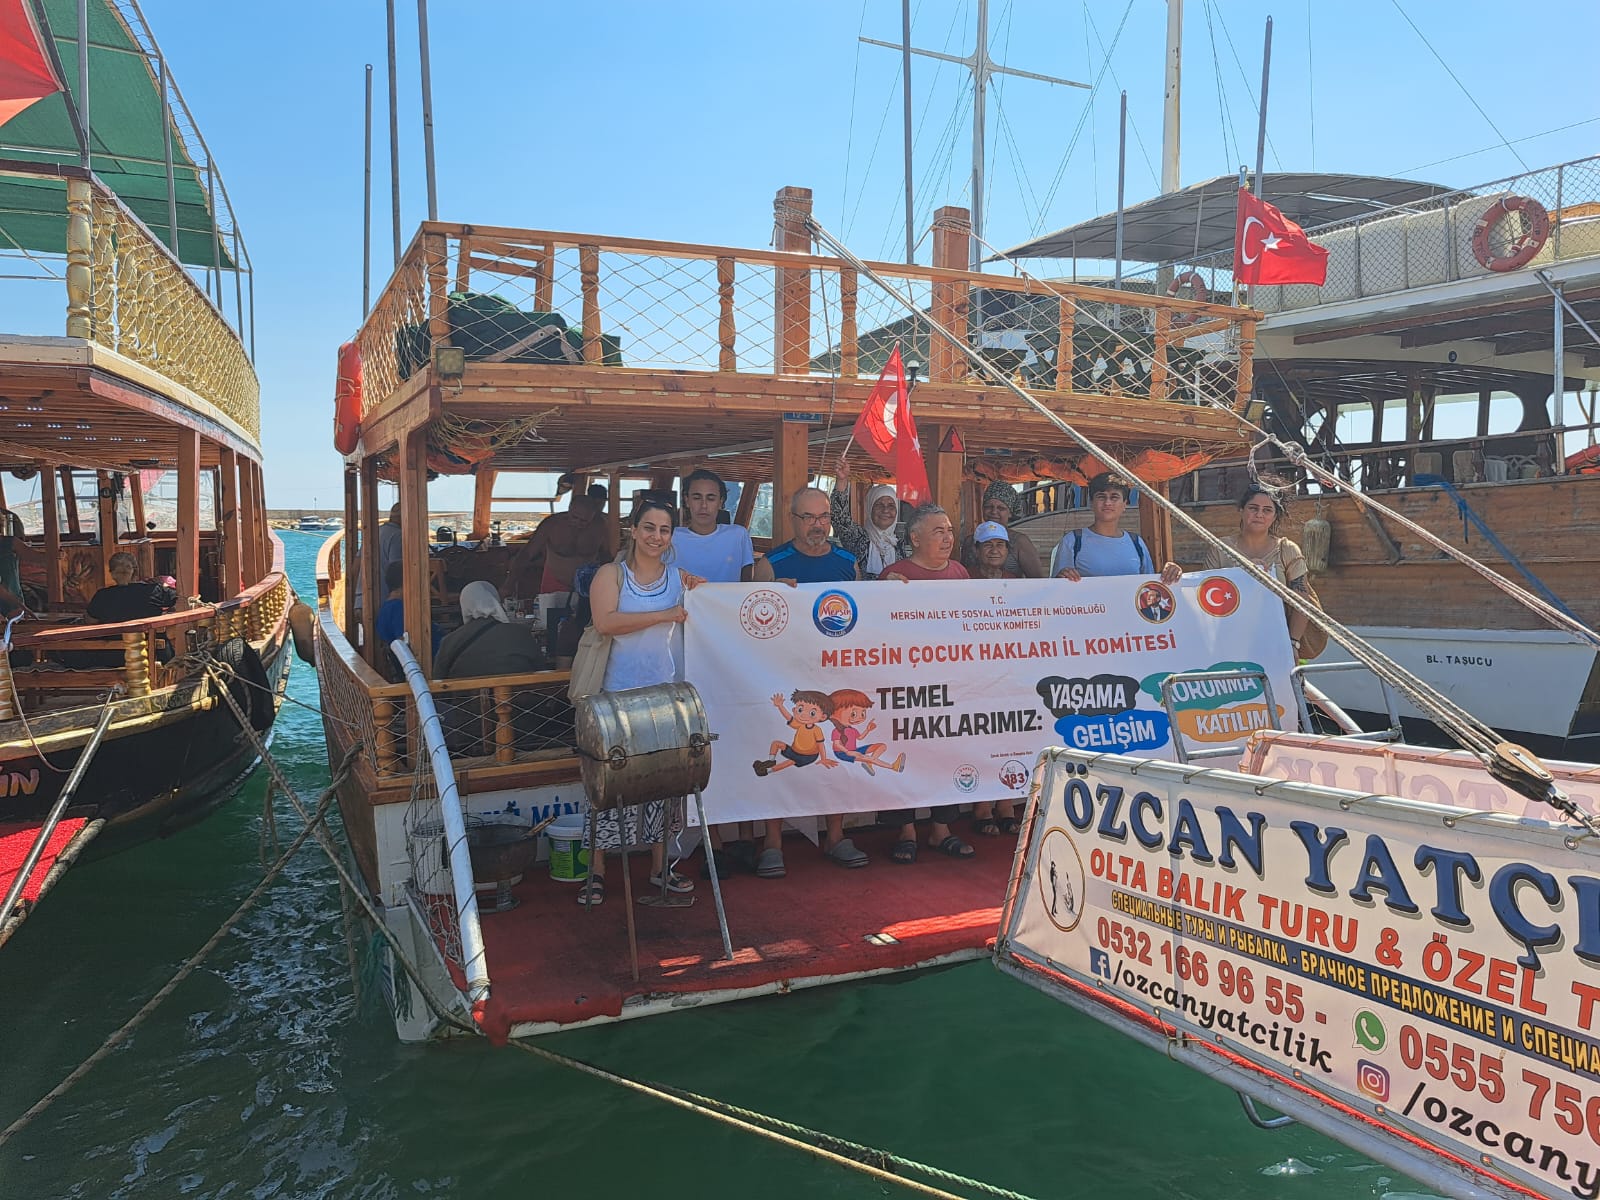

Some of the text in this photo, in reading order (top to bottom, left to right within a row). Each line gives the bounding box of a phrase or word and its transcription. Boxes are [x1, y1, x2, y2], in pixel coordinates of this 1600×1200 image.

[890, 609, 925, 620] MERSİN
[927, 608, 947, 620] AİLE
[949, 610, 960, 619] VE
[962, 608, 994, 619] SOSYAL
[996, 606, 1042, 618] HİZMETLER
[1044, 605, 1051, 616] İL
[990, 596, 1006, 605] T.C.
[963, 619, 1041, 632] İL ÇOCUK KOMİTESİ
[821, 629, 1177, 668] MERSİN ÇOCUK HAKLARI İL KOMİTESİ
[1426, 655, 1443, 664] BL.
[876, 684, 954, 710] TEMEL
[1050, 683, 1127, 714] YAŞAMA
[892, 709, 1043, 741] HAKLARIMIZ:
[1073, 716, 1156, 749] GELİŞİM
[1196, 709, 1269, 736] KATILIM
[1063, 762, 1267, 880] ÖZCAN
[1090, 848, 1147, 892] OLTA
[1157, 866, 1247, 922] BALIK
[1257, 893, 1358, 953] TURU
[1375, 927, 1403, 969] &
[1422, 932, 1547, 1016] ÖZEL
[1097, 916, 1152, 967] 0532
[1160, 940, 1209, 987] 166
[1218, 959, 1255, 1005] 96
[1265, 975, 1305, 1024] 55
[1111, 890, 1183, 932] СПЕЦИАЛЬНЫЕ
[1184, 910, 1215, 942] ТУРЫ
[1218, 921, 1227, 946] И
[1229, 926, 1290, 967] РЫБАЛКА
[1300, 949, 1367, 992] БРАЧНОЕ
[1371, 970, 1497, 1038] ПРЕДЛОЖЕНИЕ
[1501, 1014, 1516, 1045] И
[1113, 959, 1333, 1073] /ozcanyatcilik
[1399, 1024, 1506, 1104] 0555
